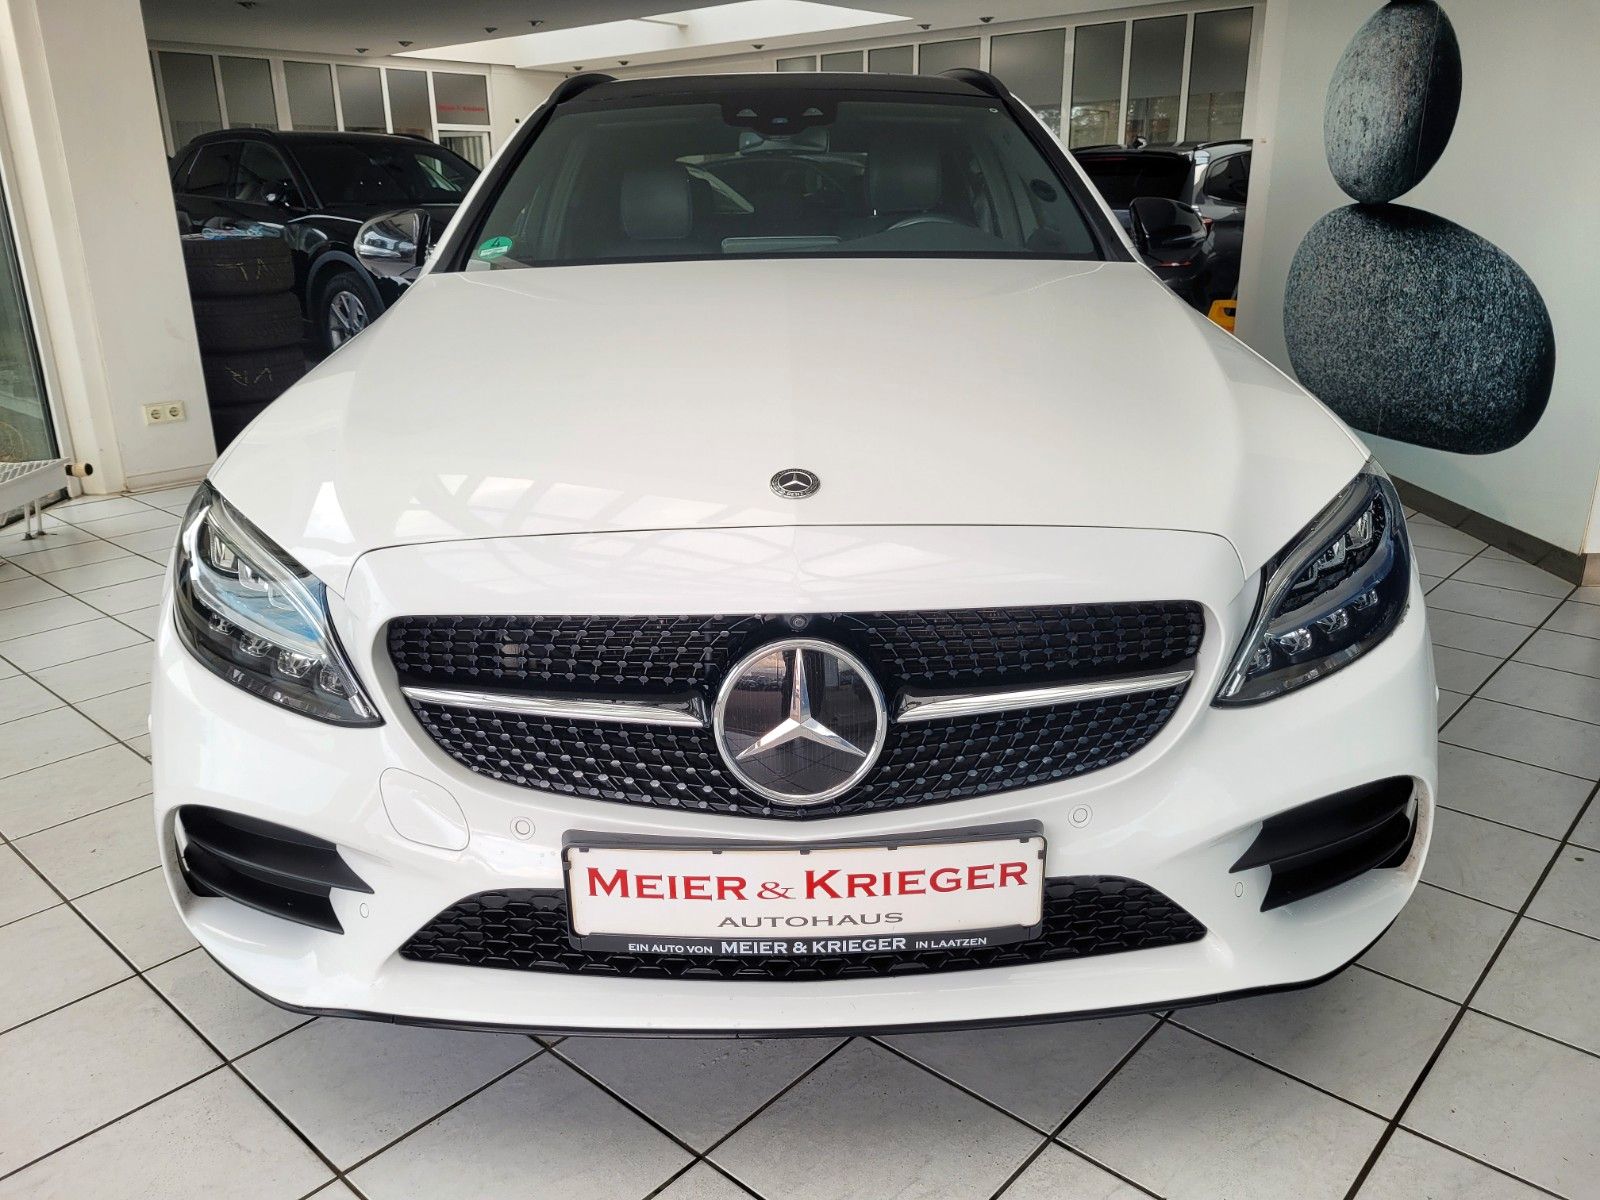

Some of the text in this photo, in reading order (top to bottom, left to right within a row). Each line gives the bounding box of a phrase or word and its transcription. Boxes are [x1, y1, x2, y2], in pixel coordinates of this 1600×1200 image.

[490, 237, 500, 247] 4
[587, 861, 1029, 901] MEIER & KRIEGER
[717, 912, 904, 928] AUTOHAUS
[628, 937, 987, 954] EIN AUTO VON MEIER & KRIEGER IN LAATZEN
